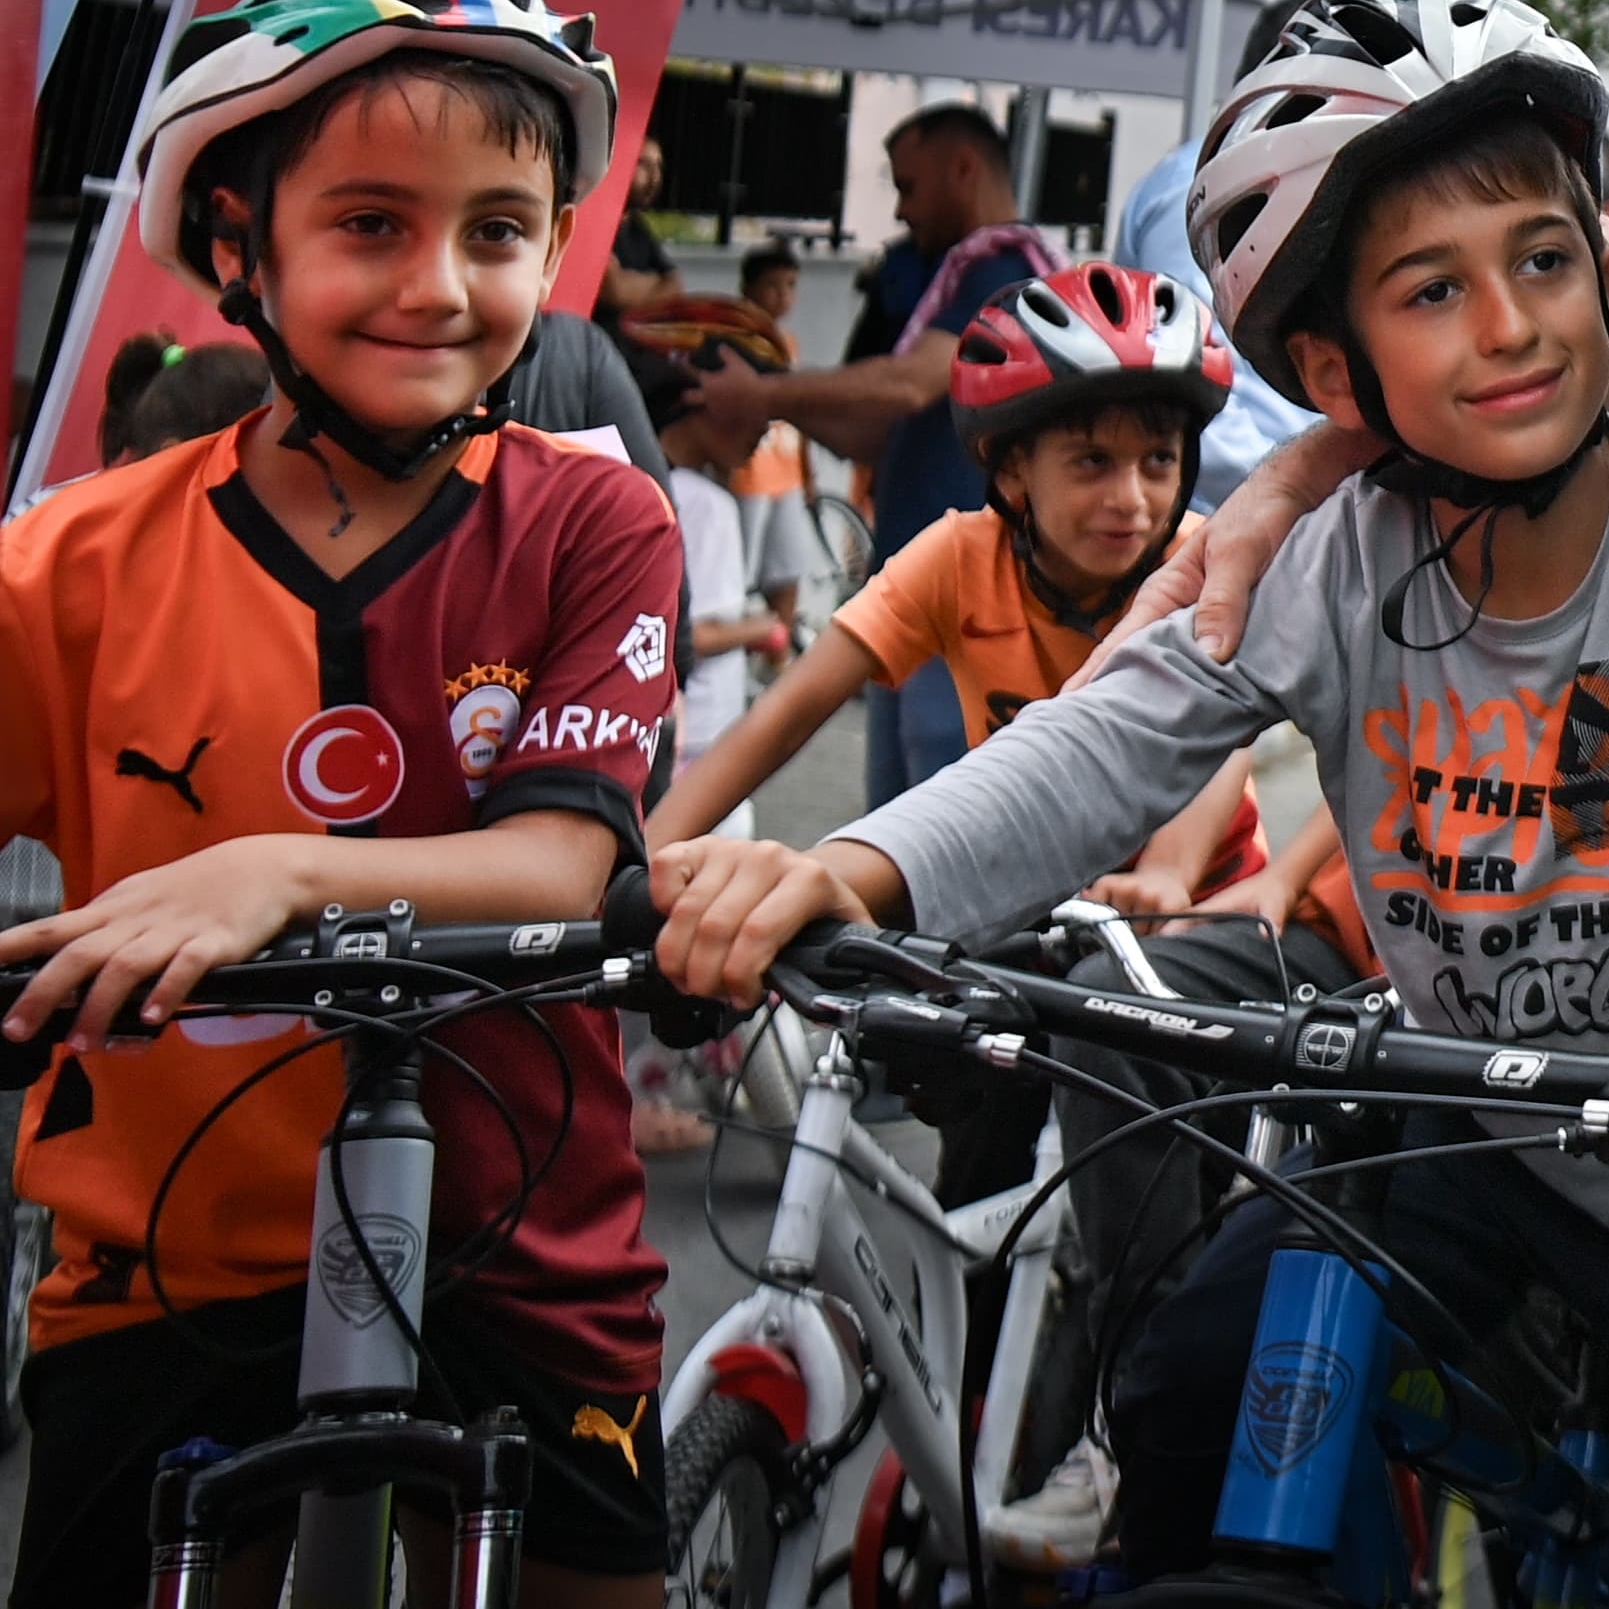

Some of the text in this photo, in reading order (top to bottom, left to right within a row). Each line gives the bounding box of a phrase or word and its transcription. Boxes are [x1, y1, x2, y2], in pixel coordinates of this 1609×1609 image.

[1451, 775, 1547, 818] THE
[1400, 826, 1517, 893] OHER
[1384, 890, 1465, 956] SIDE
[1479, 913, 1541, 958] OF
